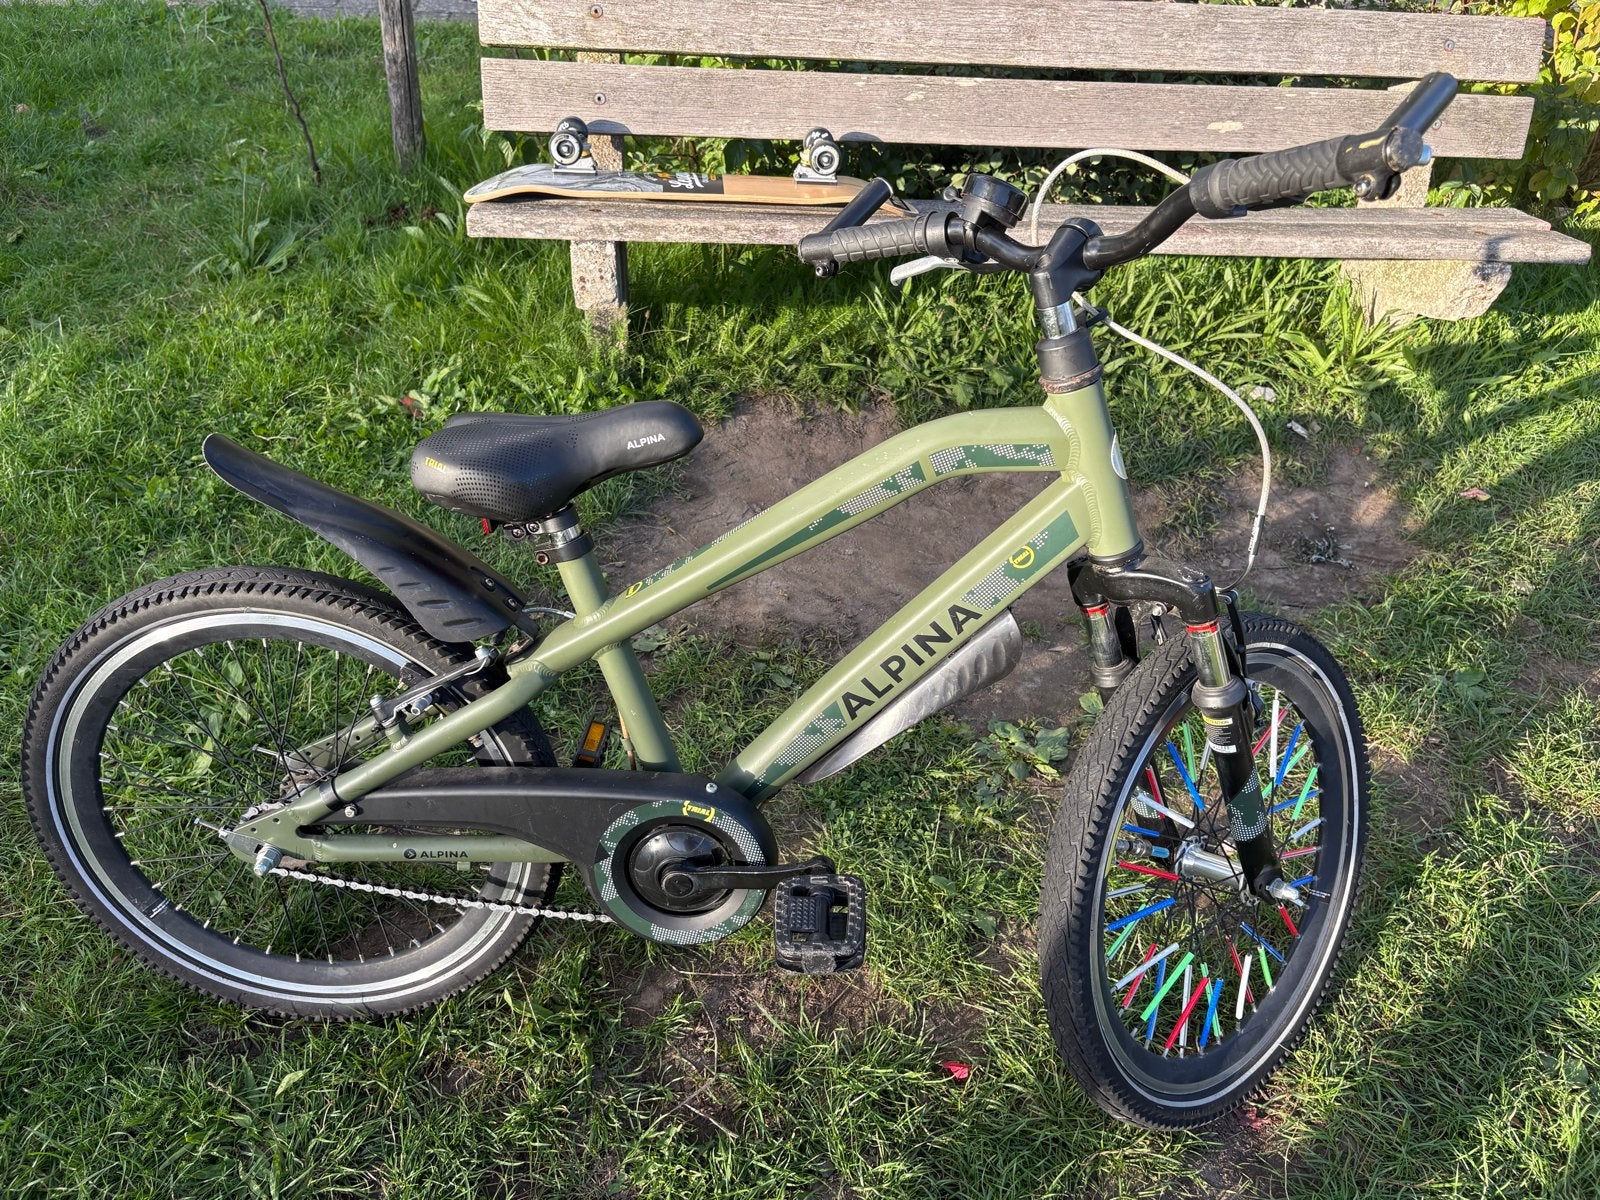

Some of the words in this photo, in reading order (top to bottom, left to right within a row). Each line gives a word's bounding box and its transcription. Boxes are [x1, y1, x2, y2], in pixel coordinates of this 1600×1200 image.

[626, 433, 665, 450] ALPINA
[425, 456, 447, 473] TRIAL
[841, 604, 983, 721] ALPINA
[687, 804, 711, 816] TRIAL
[420, 850, 469, 859] ALPINA
